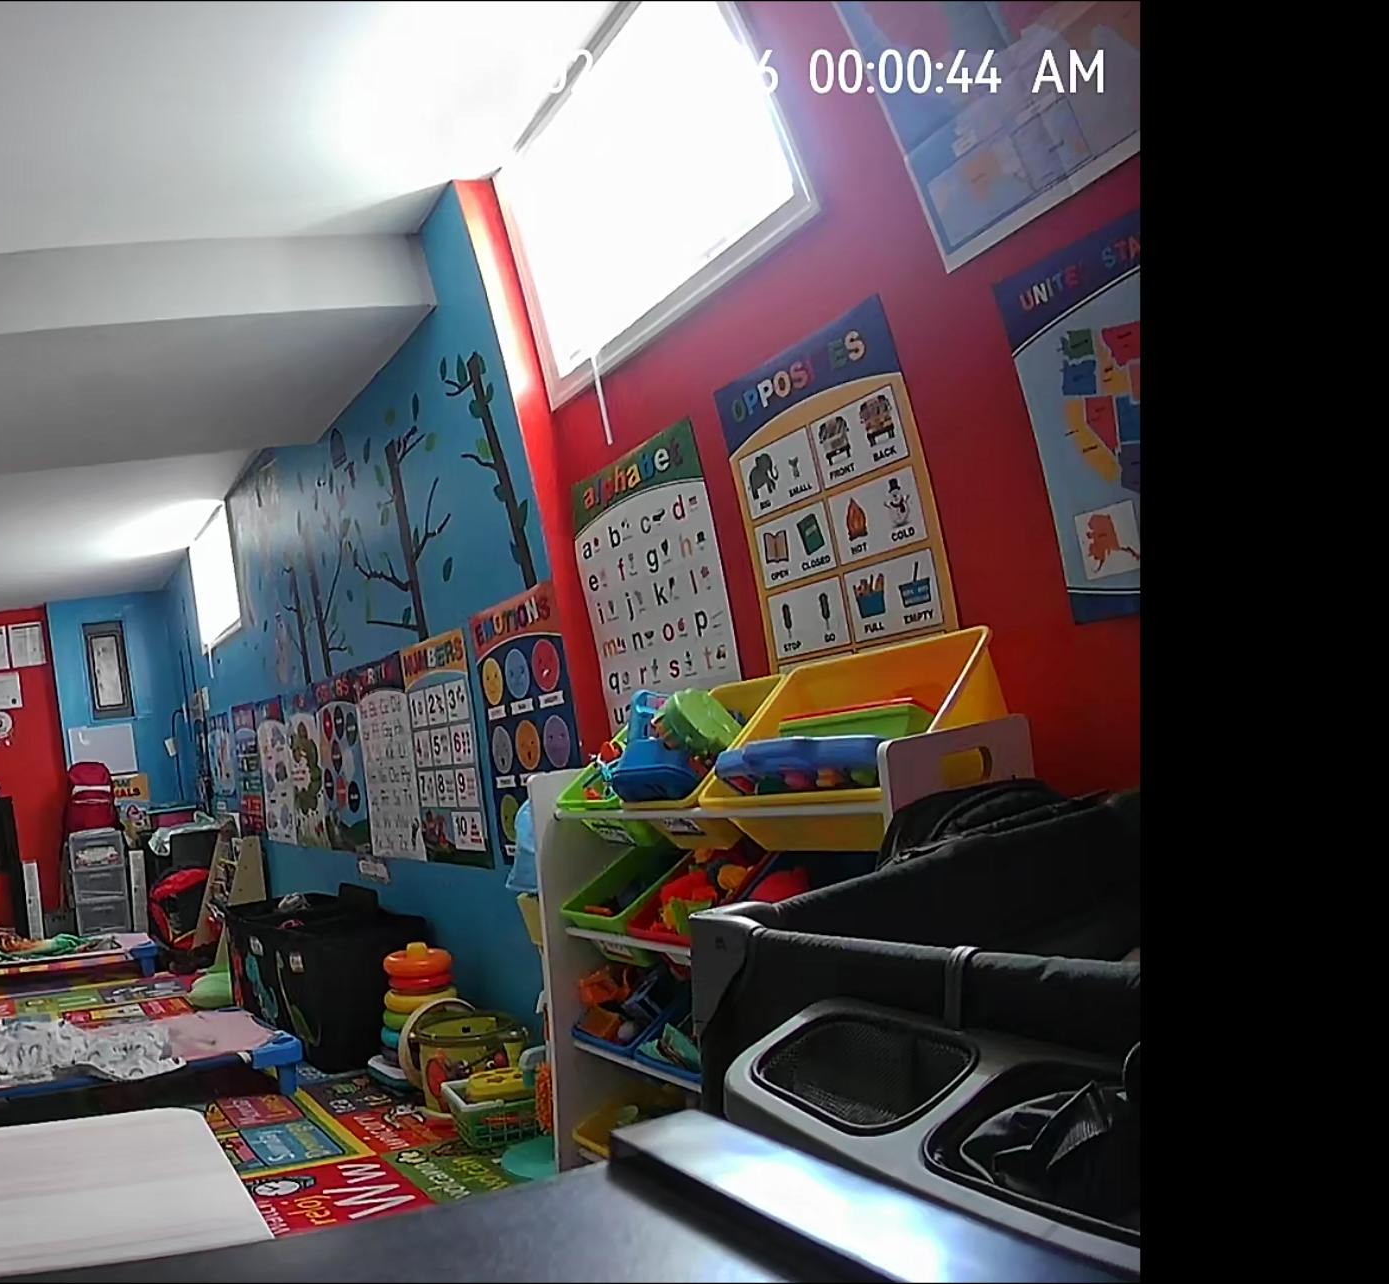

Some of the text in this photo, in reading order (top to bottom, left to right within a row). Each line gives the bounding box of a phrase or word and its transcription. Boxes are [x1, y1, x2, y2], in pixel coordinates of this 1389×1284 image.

[1019, 260, 1084, 312] UNITE
[731, 330, 866, 422] OPPOSES
[582, 437, 684, 509] alphabet
[829, 446, 898, 480] FRONT BACK
[582, 494, 686, 560] a b c d
[850, 526, 915, 555] HOT COLD
[588, 574, 599, 591] e
[617, 557, 625, 581] f
[646, 548, 659, 573] g
[770, 554, 831, 581] OPEN CLOSED
[475, 595, 551, 647] EMOTIONS
[597, 602, 605, 625] i
[624, 592, 634, 621] j
[653, 582, 669, 606] k
[631, 631, 644, 650] n
[662, 623, 675, 641] o
[694, 610, 708, 637] p
[863, 609, 934, 634] FULL EMPTY
[403, 637, 463, 678] NUMBERS
[783, 632, 836, 652] STOP GO
[608, 671, 620, 694] q
[639, 665, 647, 684] r
[669, 659, 680, 678] s
[428, 694, 436, 714] 2
[448, 690, 456, 710] 3
[433, 735, 440, 756] 5
[454, 732, 461, 753] 6
[419, 772, 465, 794] 7 8 9
[456, 815, 468, 837] 10
[322, 1163, 417, 1220] Ww
[287, 1194, 339, 1225] reloj
